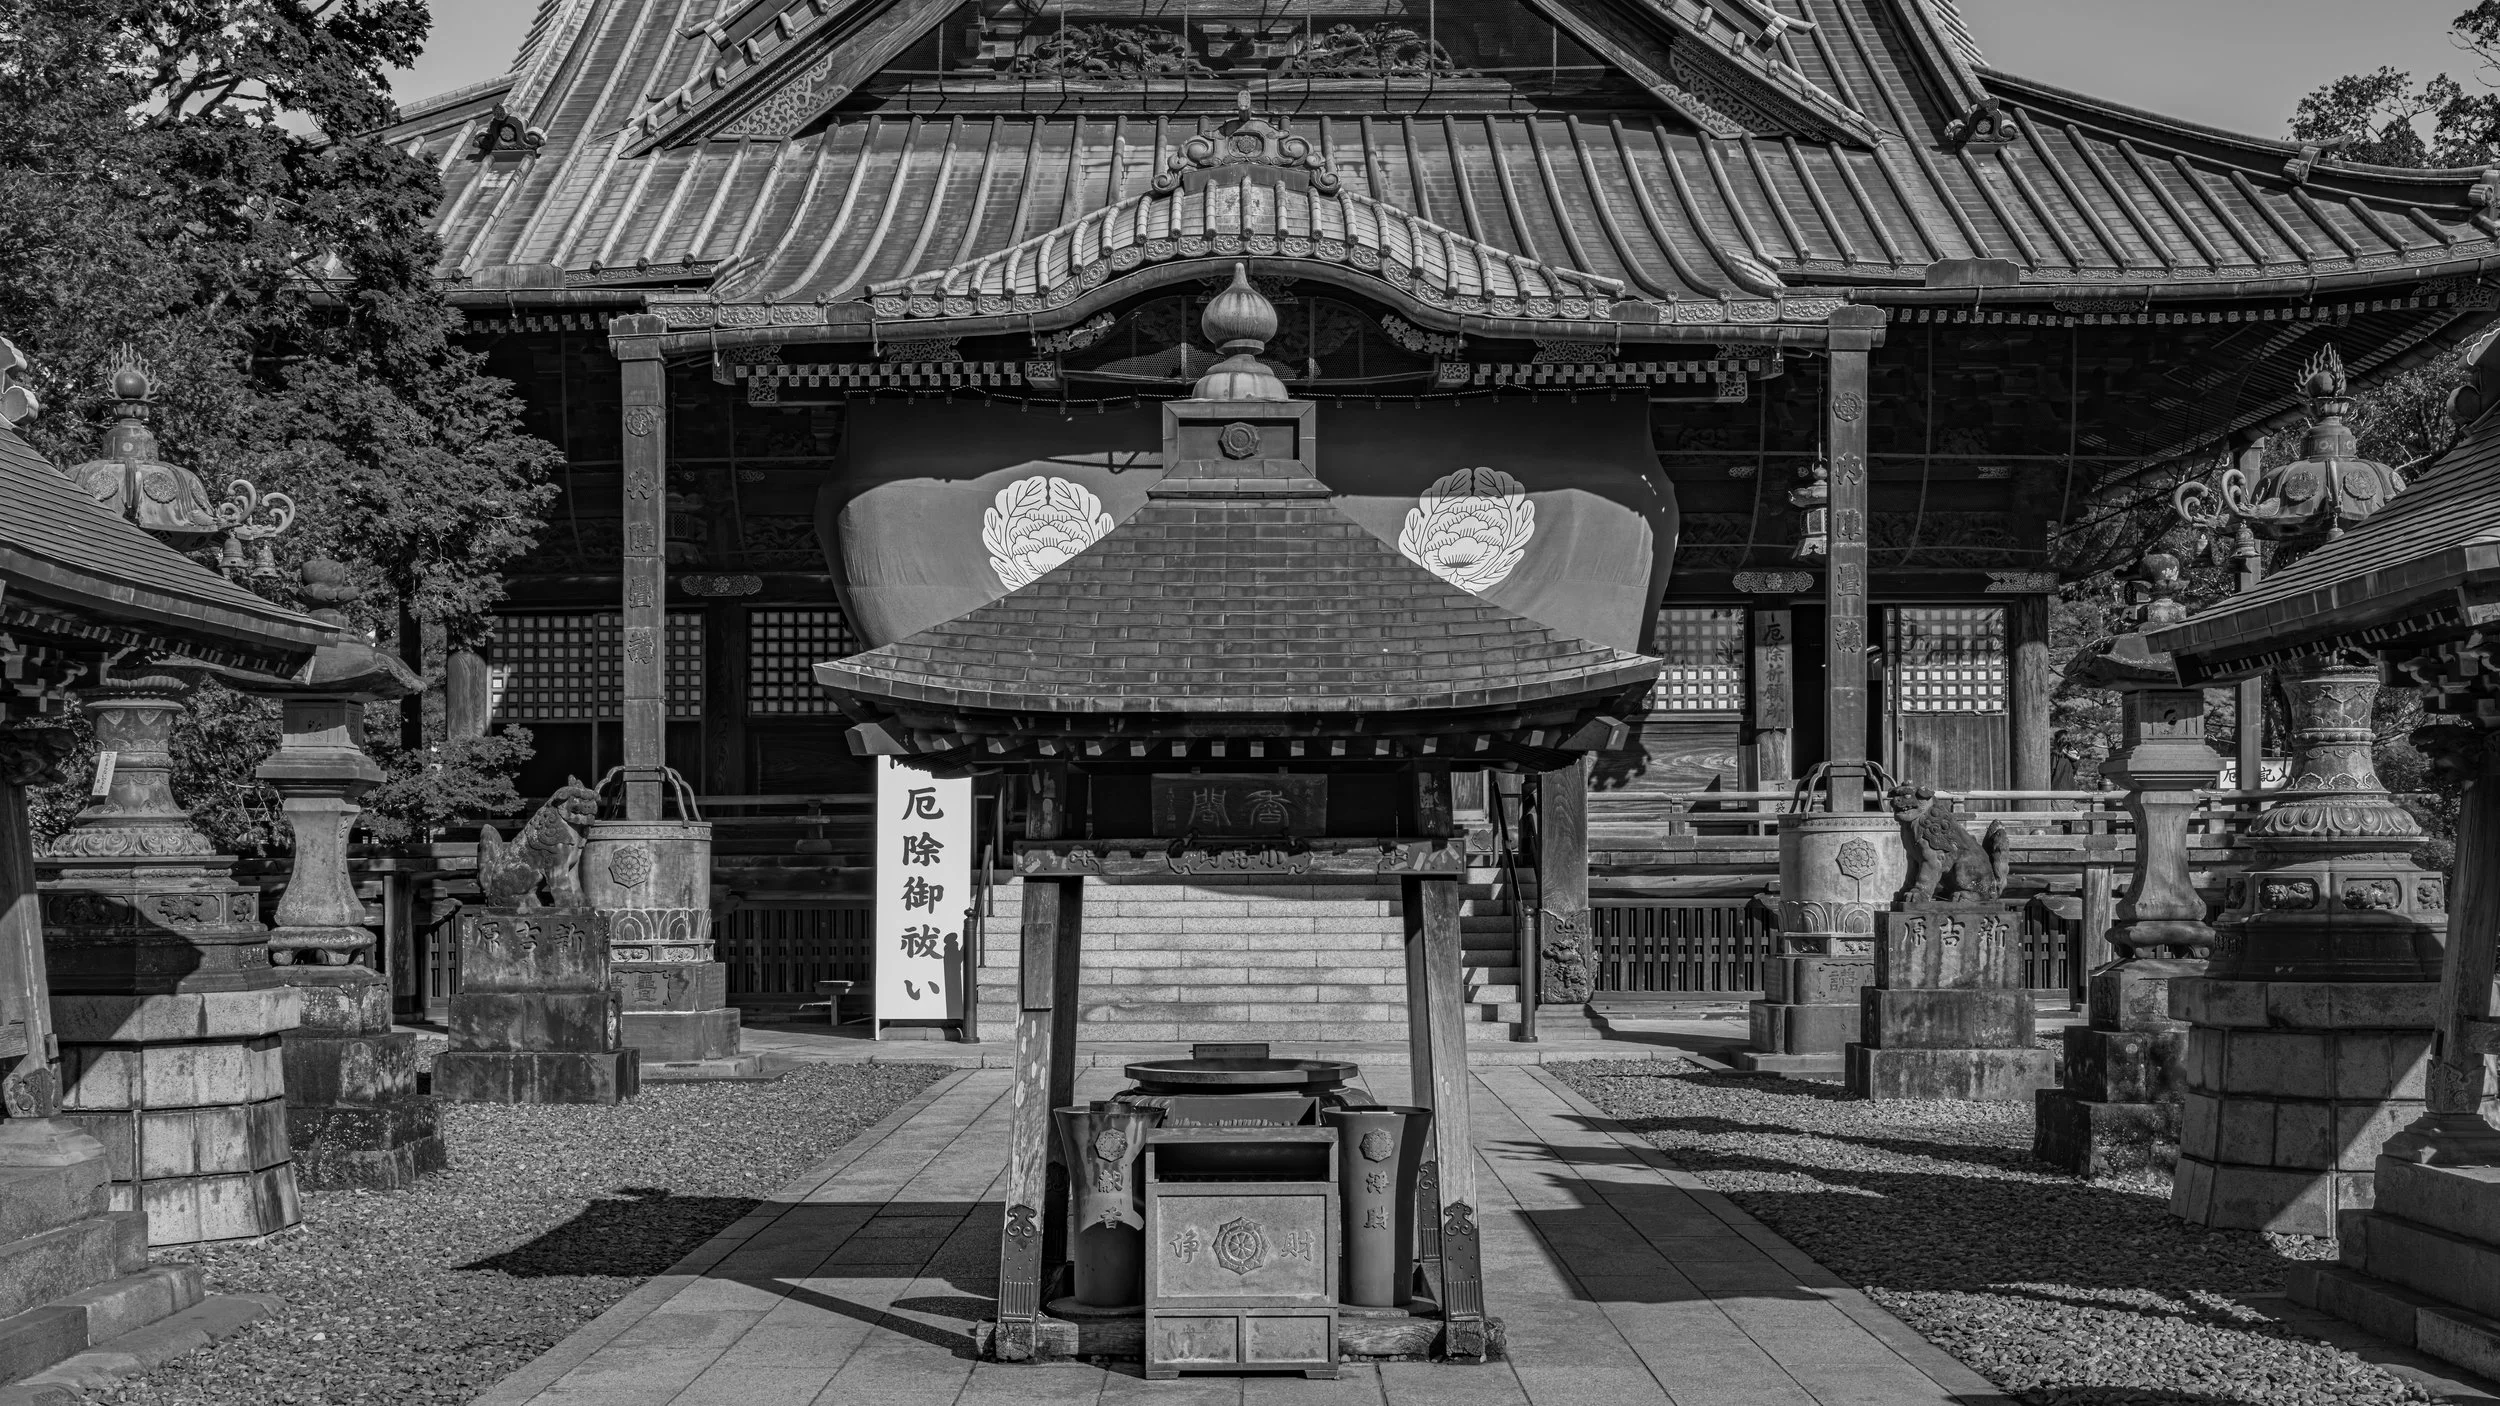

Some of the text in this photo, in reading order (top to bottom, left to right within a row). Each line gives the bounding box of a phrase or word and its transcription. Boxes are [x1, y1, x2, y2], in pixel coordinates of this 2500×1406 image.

[1764, 623, 1785, 723] 厄除祈願所
[1775, 782, 1785, 813] 下袋
[2222, 767, 2289, 783] 厄記入
[901, 786, 944, 1001] 厄除御祓い
